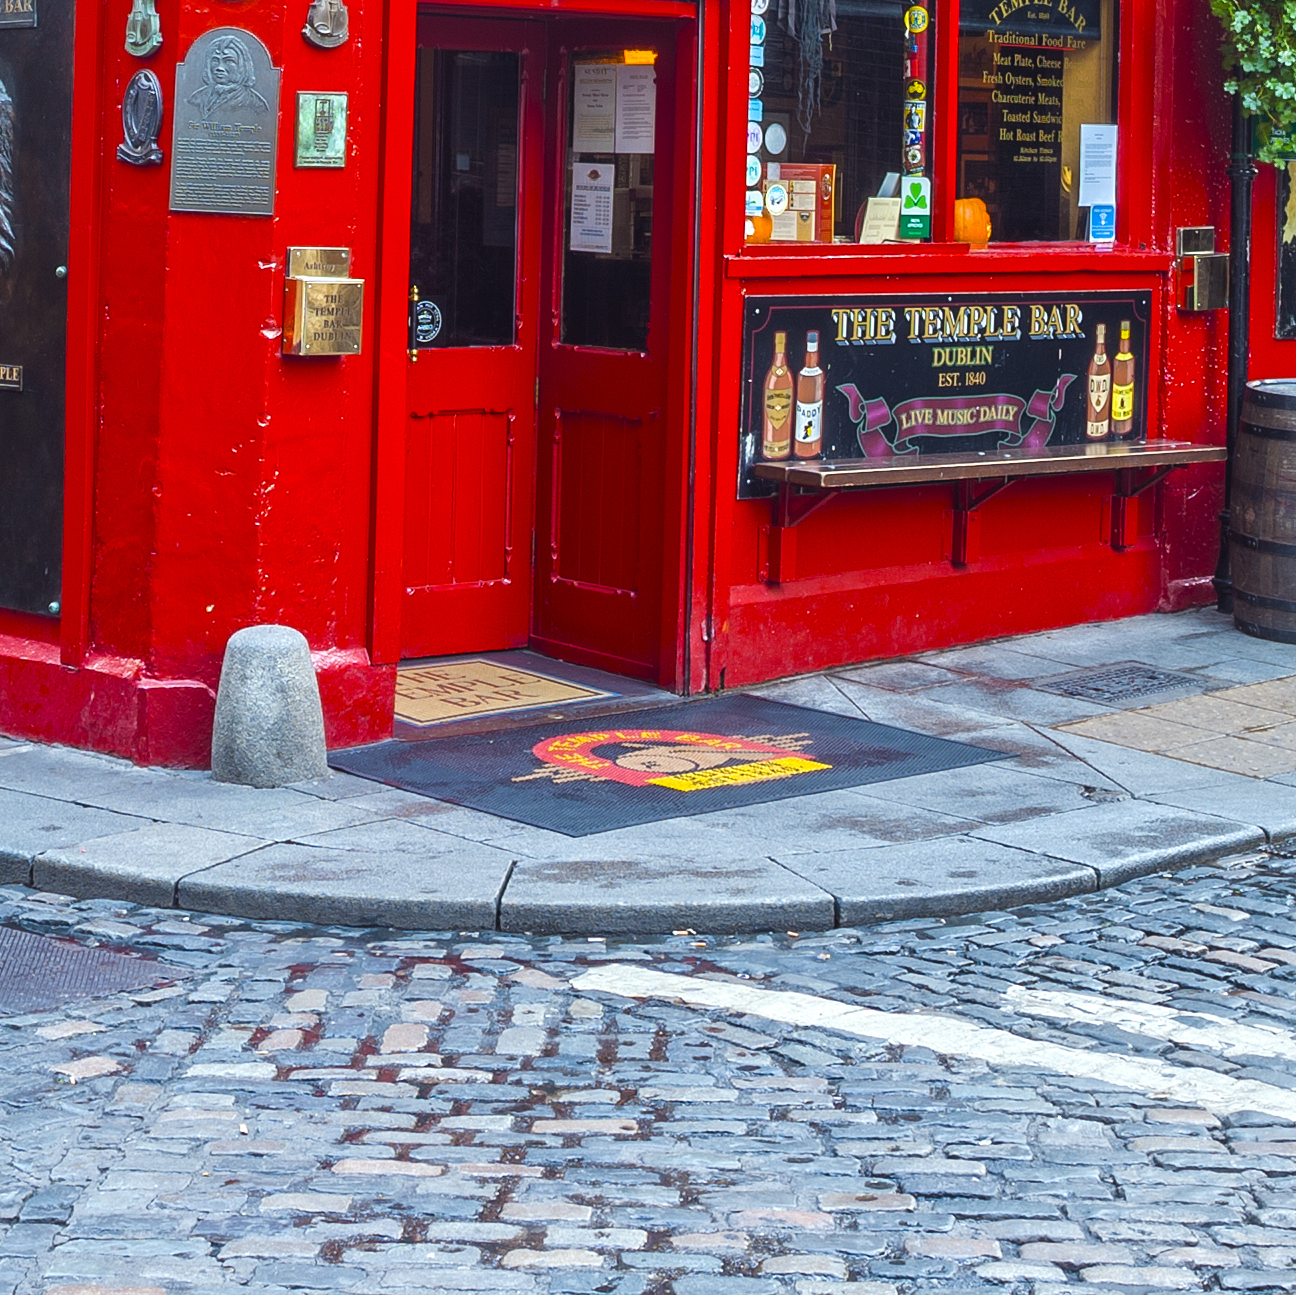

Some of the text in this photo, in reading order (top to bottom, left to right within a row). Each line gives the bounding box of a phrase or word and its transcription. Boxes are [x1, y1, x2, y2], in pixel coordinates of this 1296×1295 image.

[987, 29, 1086, 50] Traditional Food Fare
[992, 52, 1012, 66] Meat
[1013, 53, 1035, 69] Plate,
[1036, 55, 1062, 69] Cheese
[982, 70, 1035, 89] Fresh Oysters,
[991, 90, 1061, 107] Charcuterie Meats,
[1001, 109, 1031, 124] Toasted
[999, 127, 1057, 143] Hot Roast Beef
[303, 261, 336, 273] Ashtray
[323, 294, 344, 304] THE
[313, 307, 353, 317] TEMPLE
[323, 319, 344, 330] BAR
[830, 302, 1087, 346] THE TEMPLE BAR
[313, 331, 354, 342] DUBLIN
[931, 345, 994, 367] DUBLIN
[937, 370, 987, 388] EST. 1840
[900, 404, 1019, 431] LIVE MUSIC DAILY
[440, 689, 542, 709] BAR
[674, 733, 744, 751] BAR
